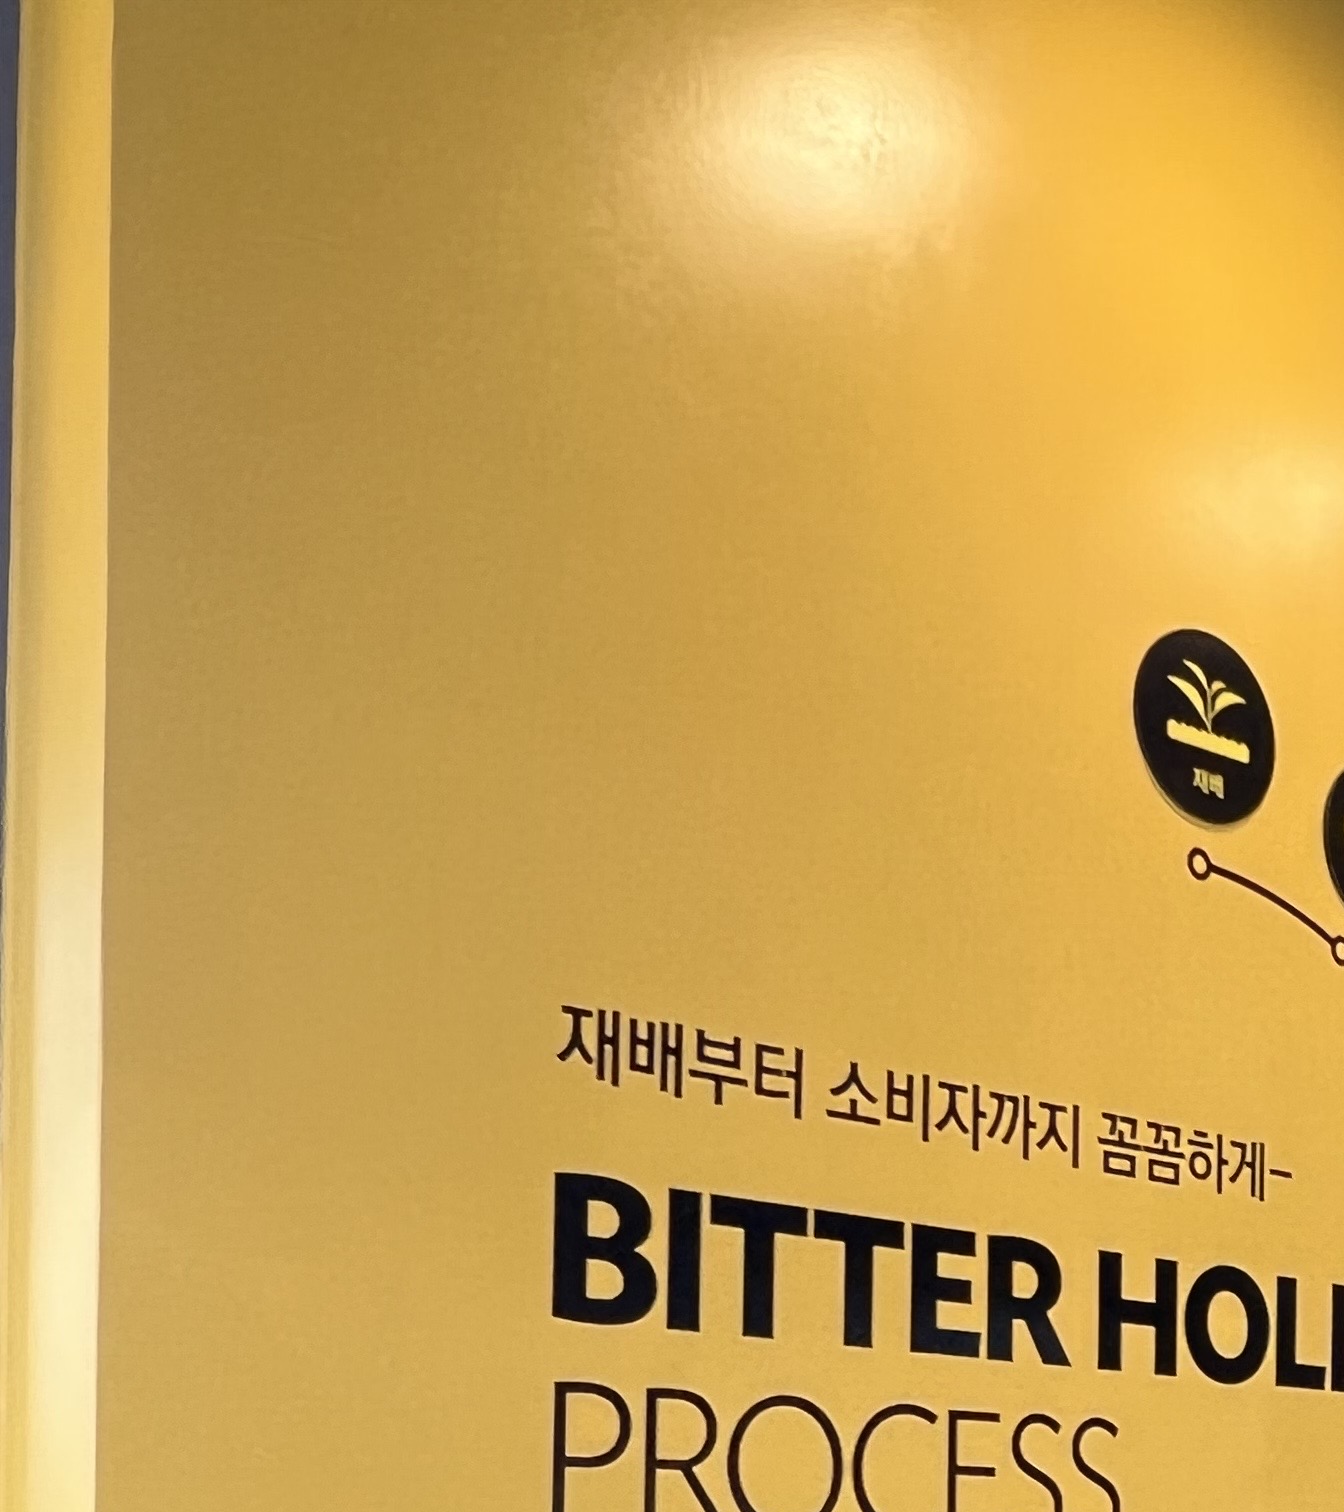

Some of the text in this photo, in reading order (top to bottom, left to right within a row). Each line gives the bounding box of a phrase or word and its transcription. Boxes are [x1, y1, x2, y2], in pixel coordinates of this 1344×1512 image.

[557, 1003, 805, 1121] 재배부터
[825, 1060, 1082, 1168] 소비자까지
[550, 1171, 1072, 1368] BITTER
